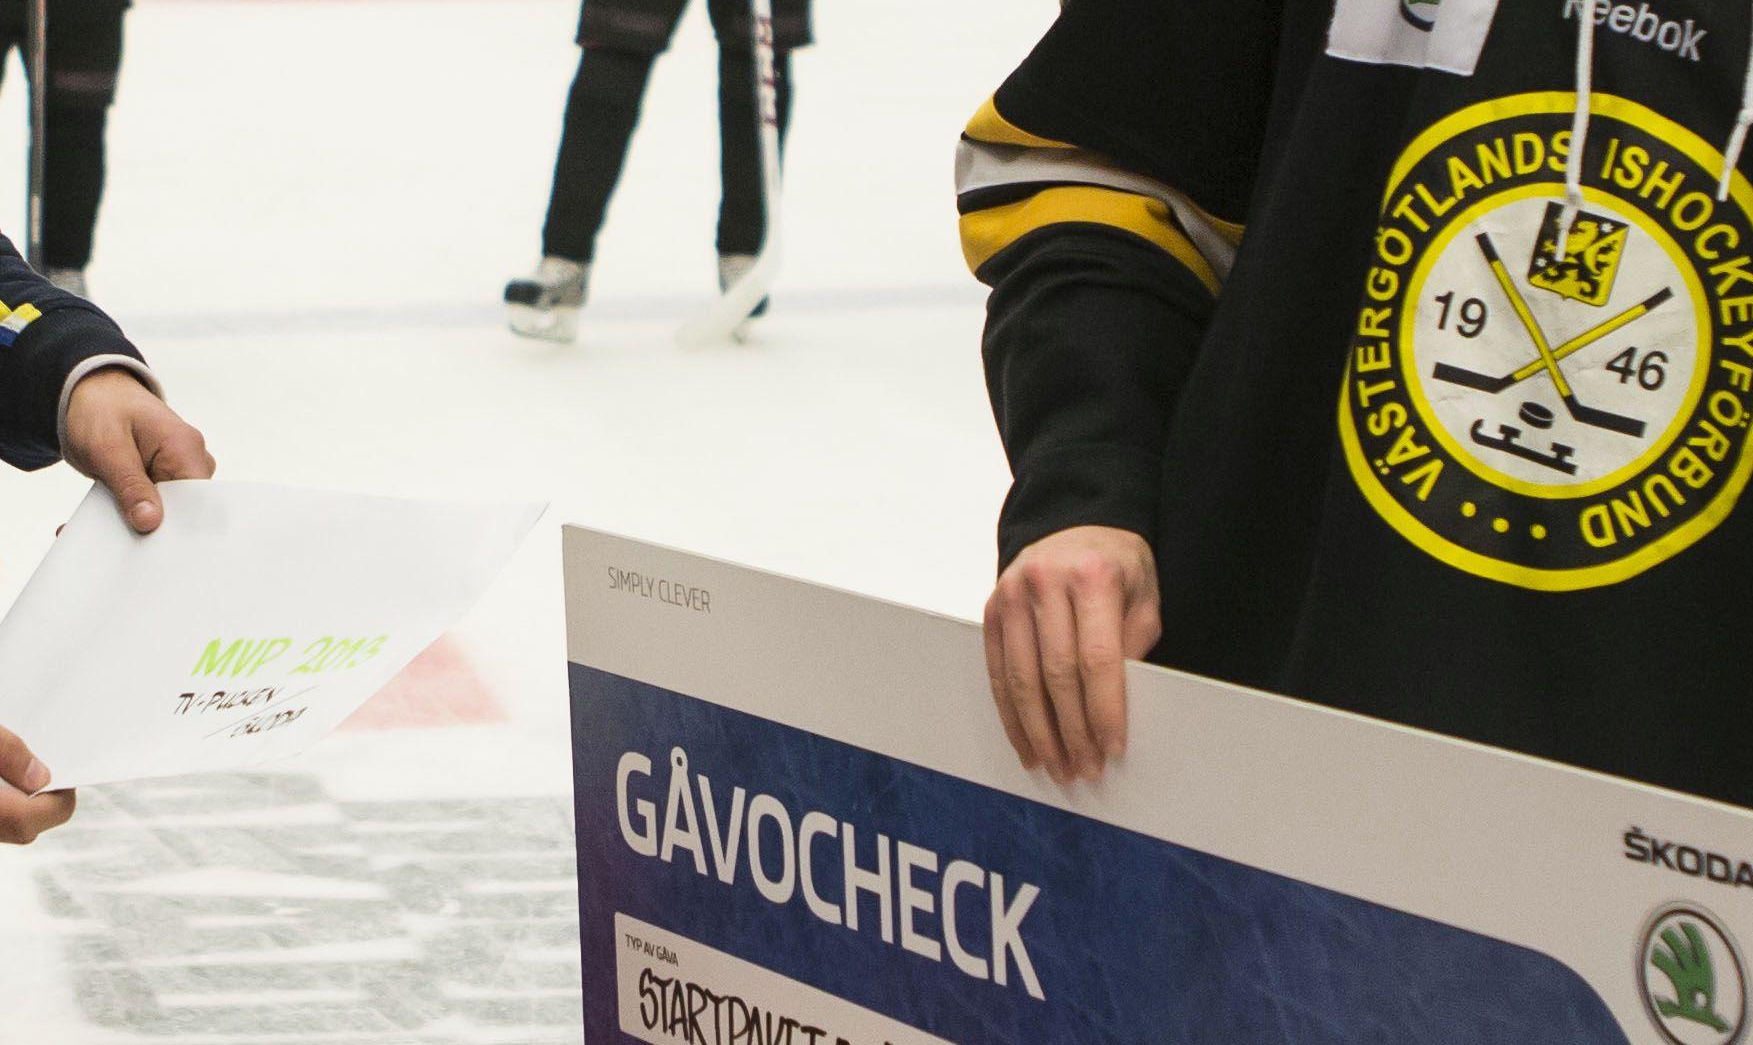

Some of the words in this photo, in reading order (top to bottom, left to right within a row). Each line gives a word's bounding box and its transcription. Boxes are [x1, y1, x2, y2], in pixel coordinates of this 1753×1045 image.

[1356, 130, 1577, 502] VÄSTERGÖTLANDS
[1432, 290, 1488, 339] 19
[1605, 345, 1666, 392] 46
[607, 565, 654, 598] SIMPLY
[657, 578, 712, 614] CLEVER
[190, 637, 294, 678] MVP
[615, 746, 1047, 1002] GÅVOCHECK
[625, 933, 643, 951] TYP
[643, 941, 656, 957] AV
